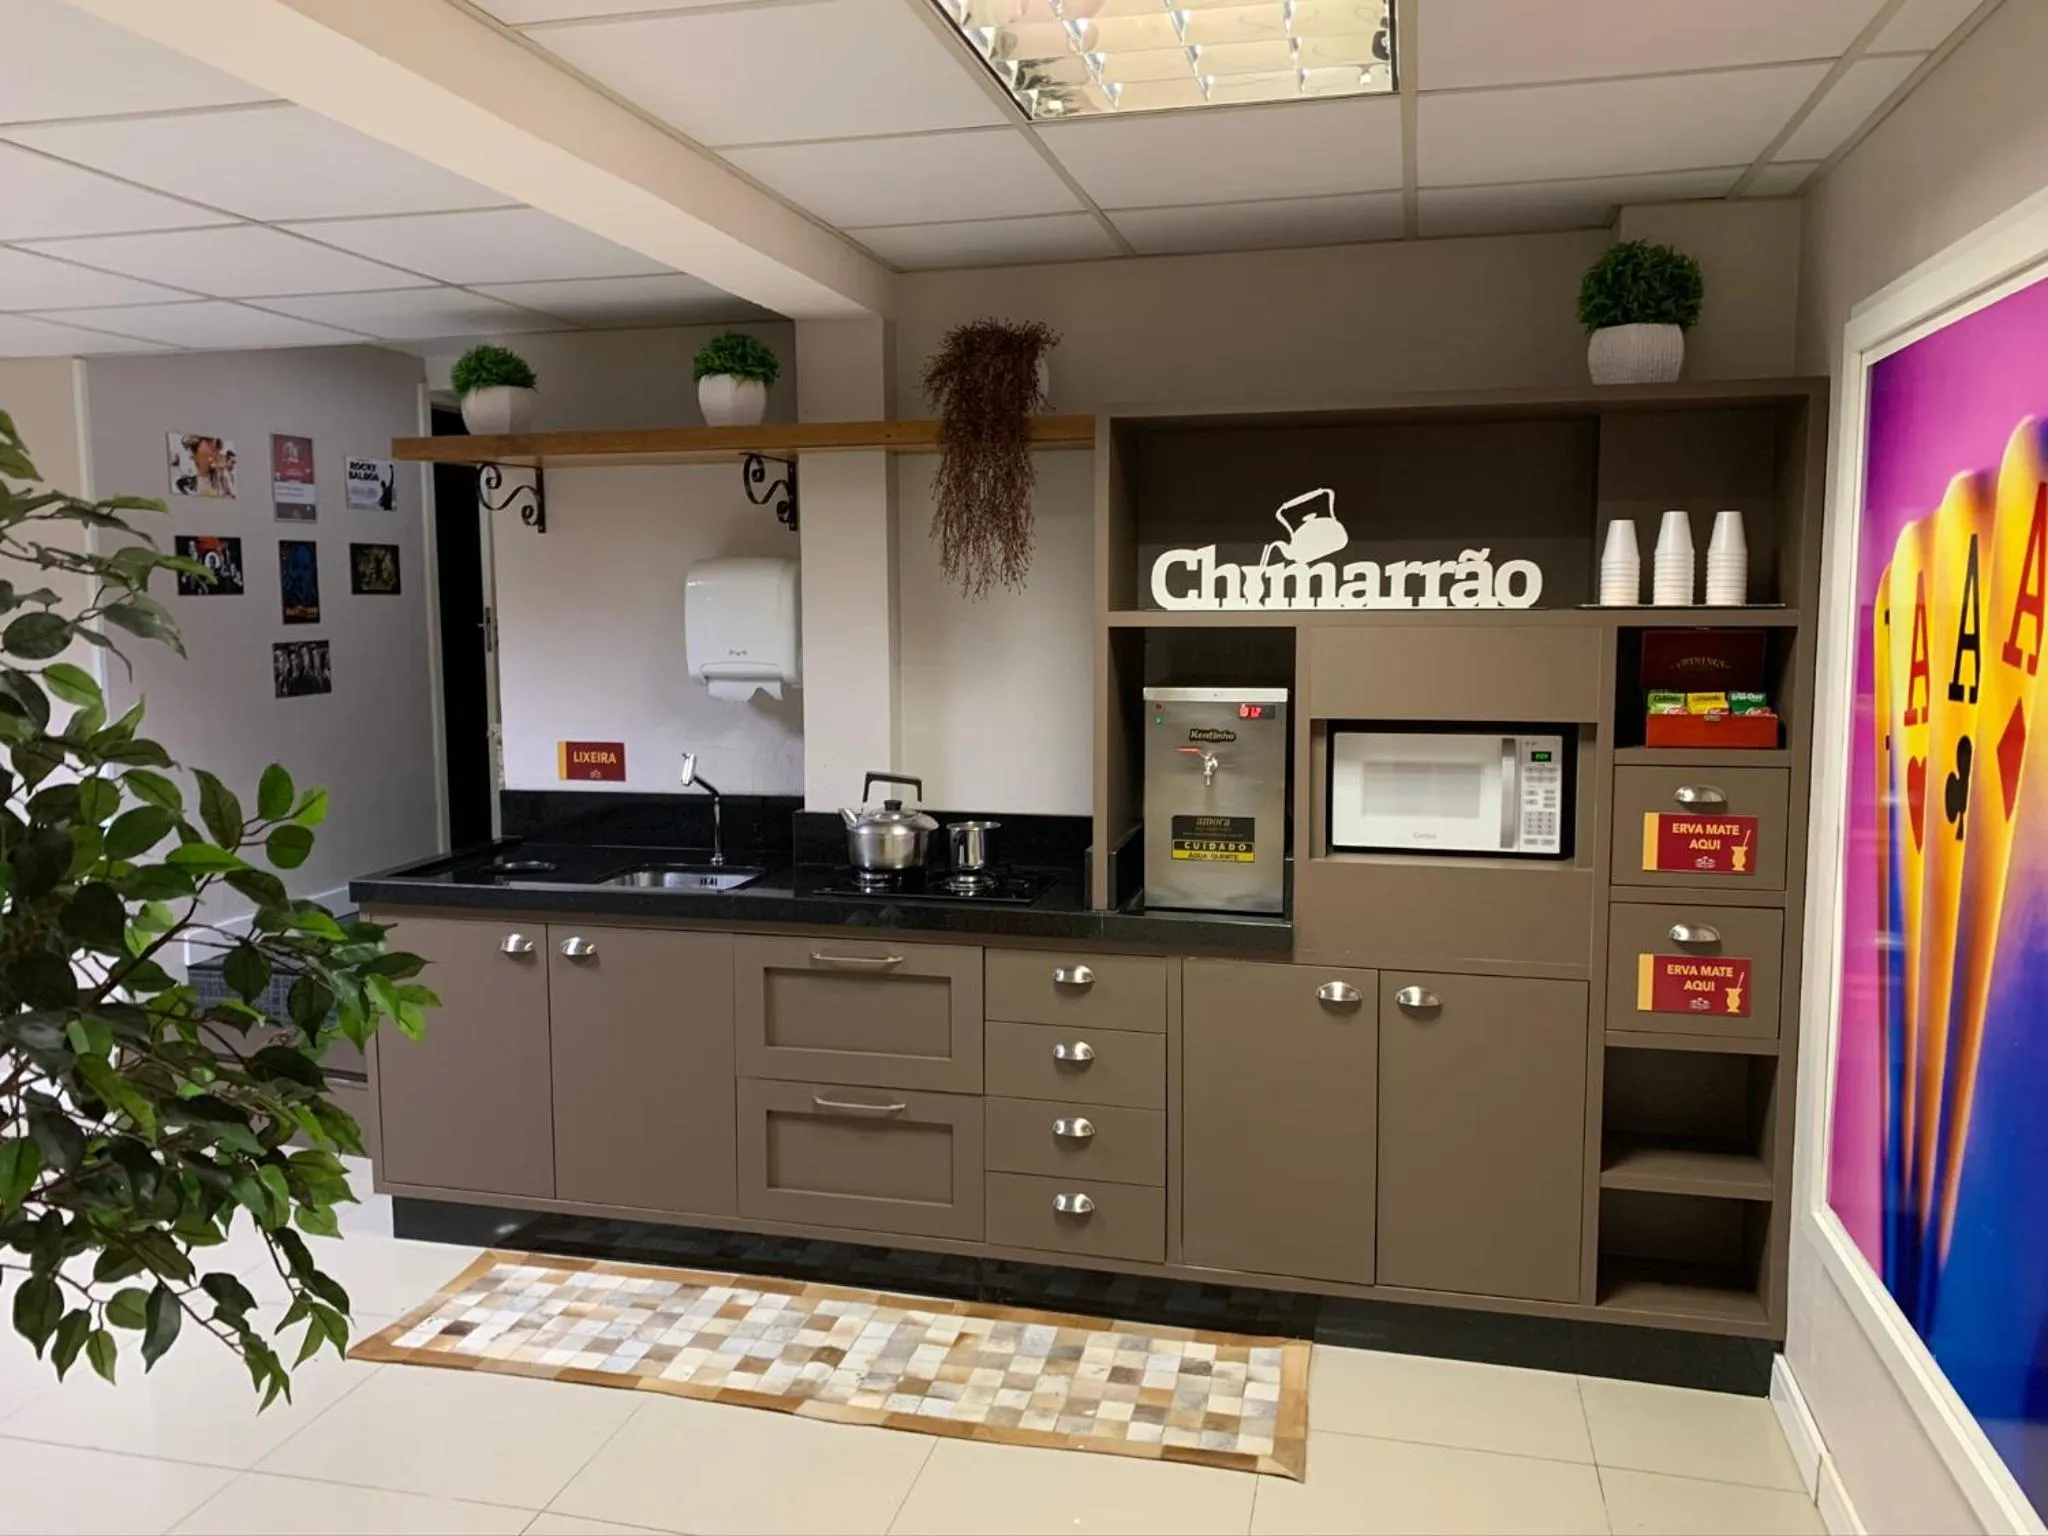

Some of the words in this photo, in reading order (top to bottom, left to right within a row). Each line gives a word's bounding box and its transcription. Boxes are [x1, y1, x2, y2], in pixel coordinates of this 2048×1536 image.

[2002, 481, 2048, 676] A
[1948, 533, 1981, 704] A
[1905, 570, 1930, 726] A
[573, 750, 617, 764] LIXEIRA
[1672, 822, 1703, 835] ERVA
[1706, 824, 1740, 836] MATE
[1184, 841, 1247, 851] CUIDADO
[1689, 838, 1721, 850] AQUI
[1667, 963, 1698, 976] ERVA
[1700, 965, 1734, 978] MATE
[1683, 980, 1715, 992] AQUI
